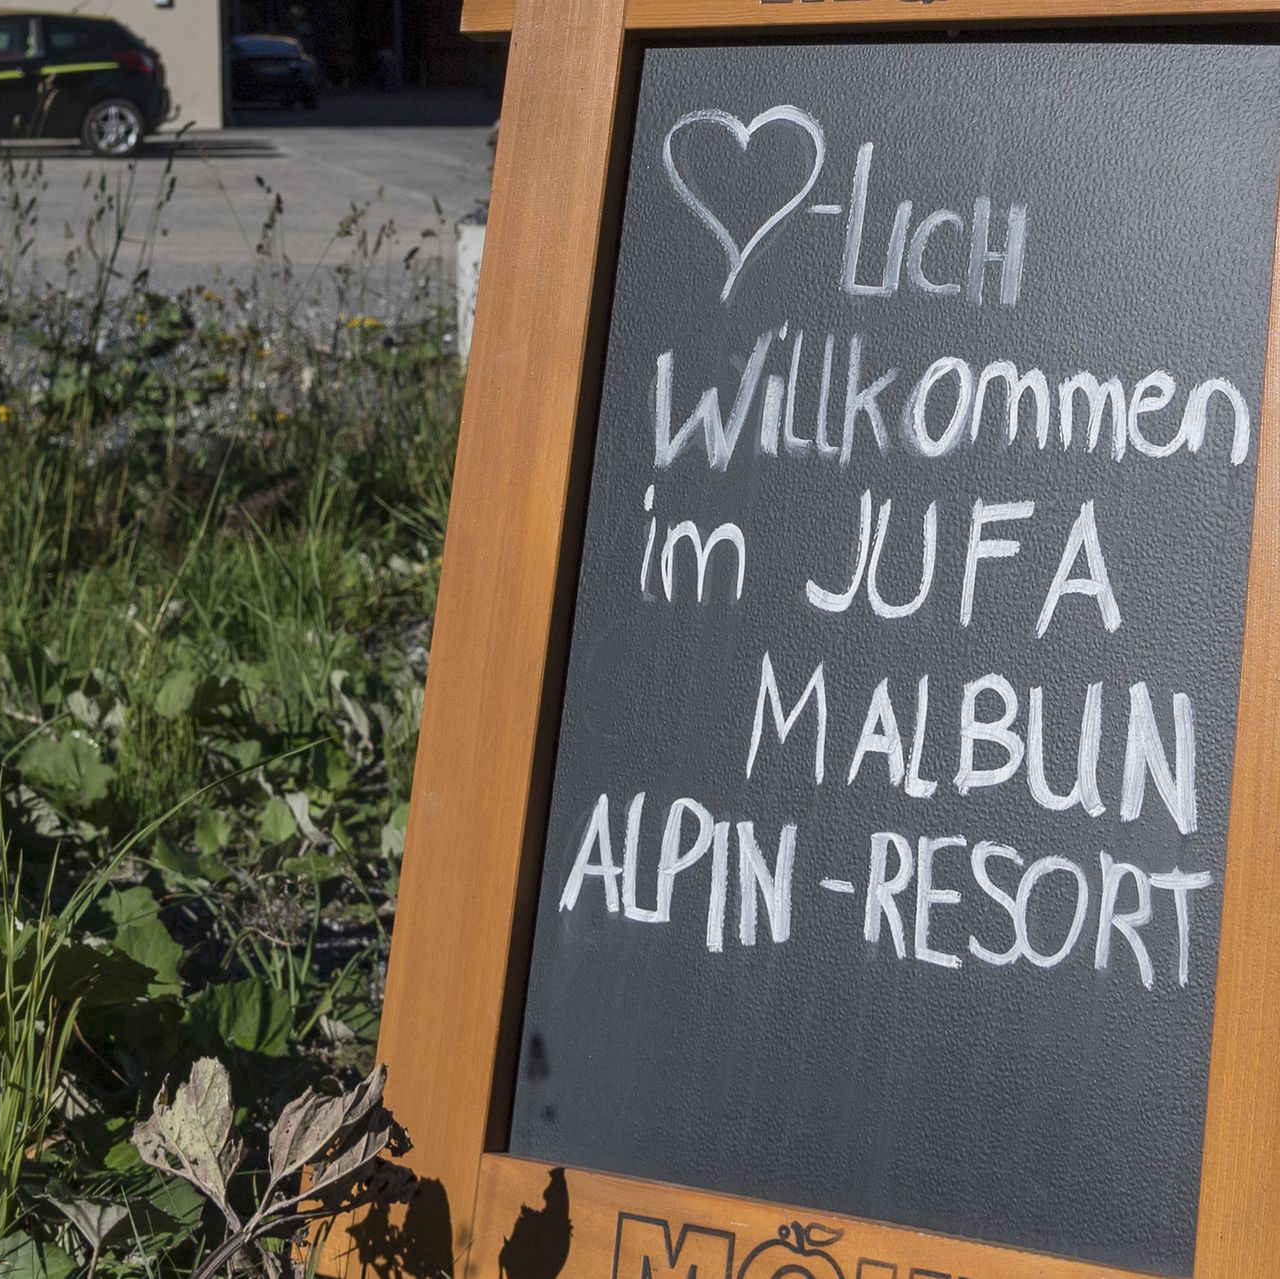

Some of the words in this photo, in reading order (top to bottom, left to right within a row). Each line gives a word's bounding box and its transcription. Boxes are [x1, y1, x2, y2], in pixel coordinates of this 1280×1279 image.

[654, 323, 1251, 471] Willkommen
[639, 484, 747, 604] im
[805, 489, 1122, 639] JUFA
[746, 651, 1199, 835] MALBUN
